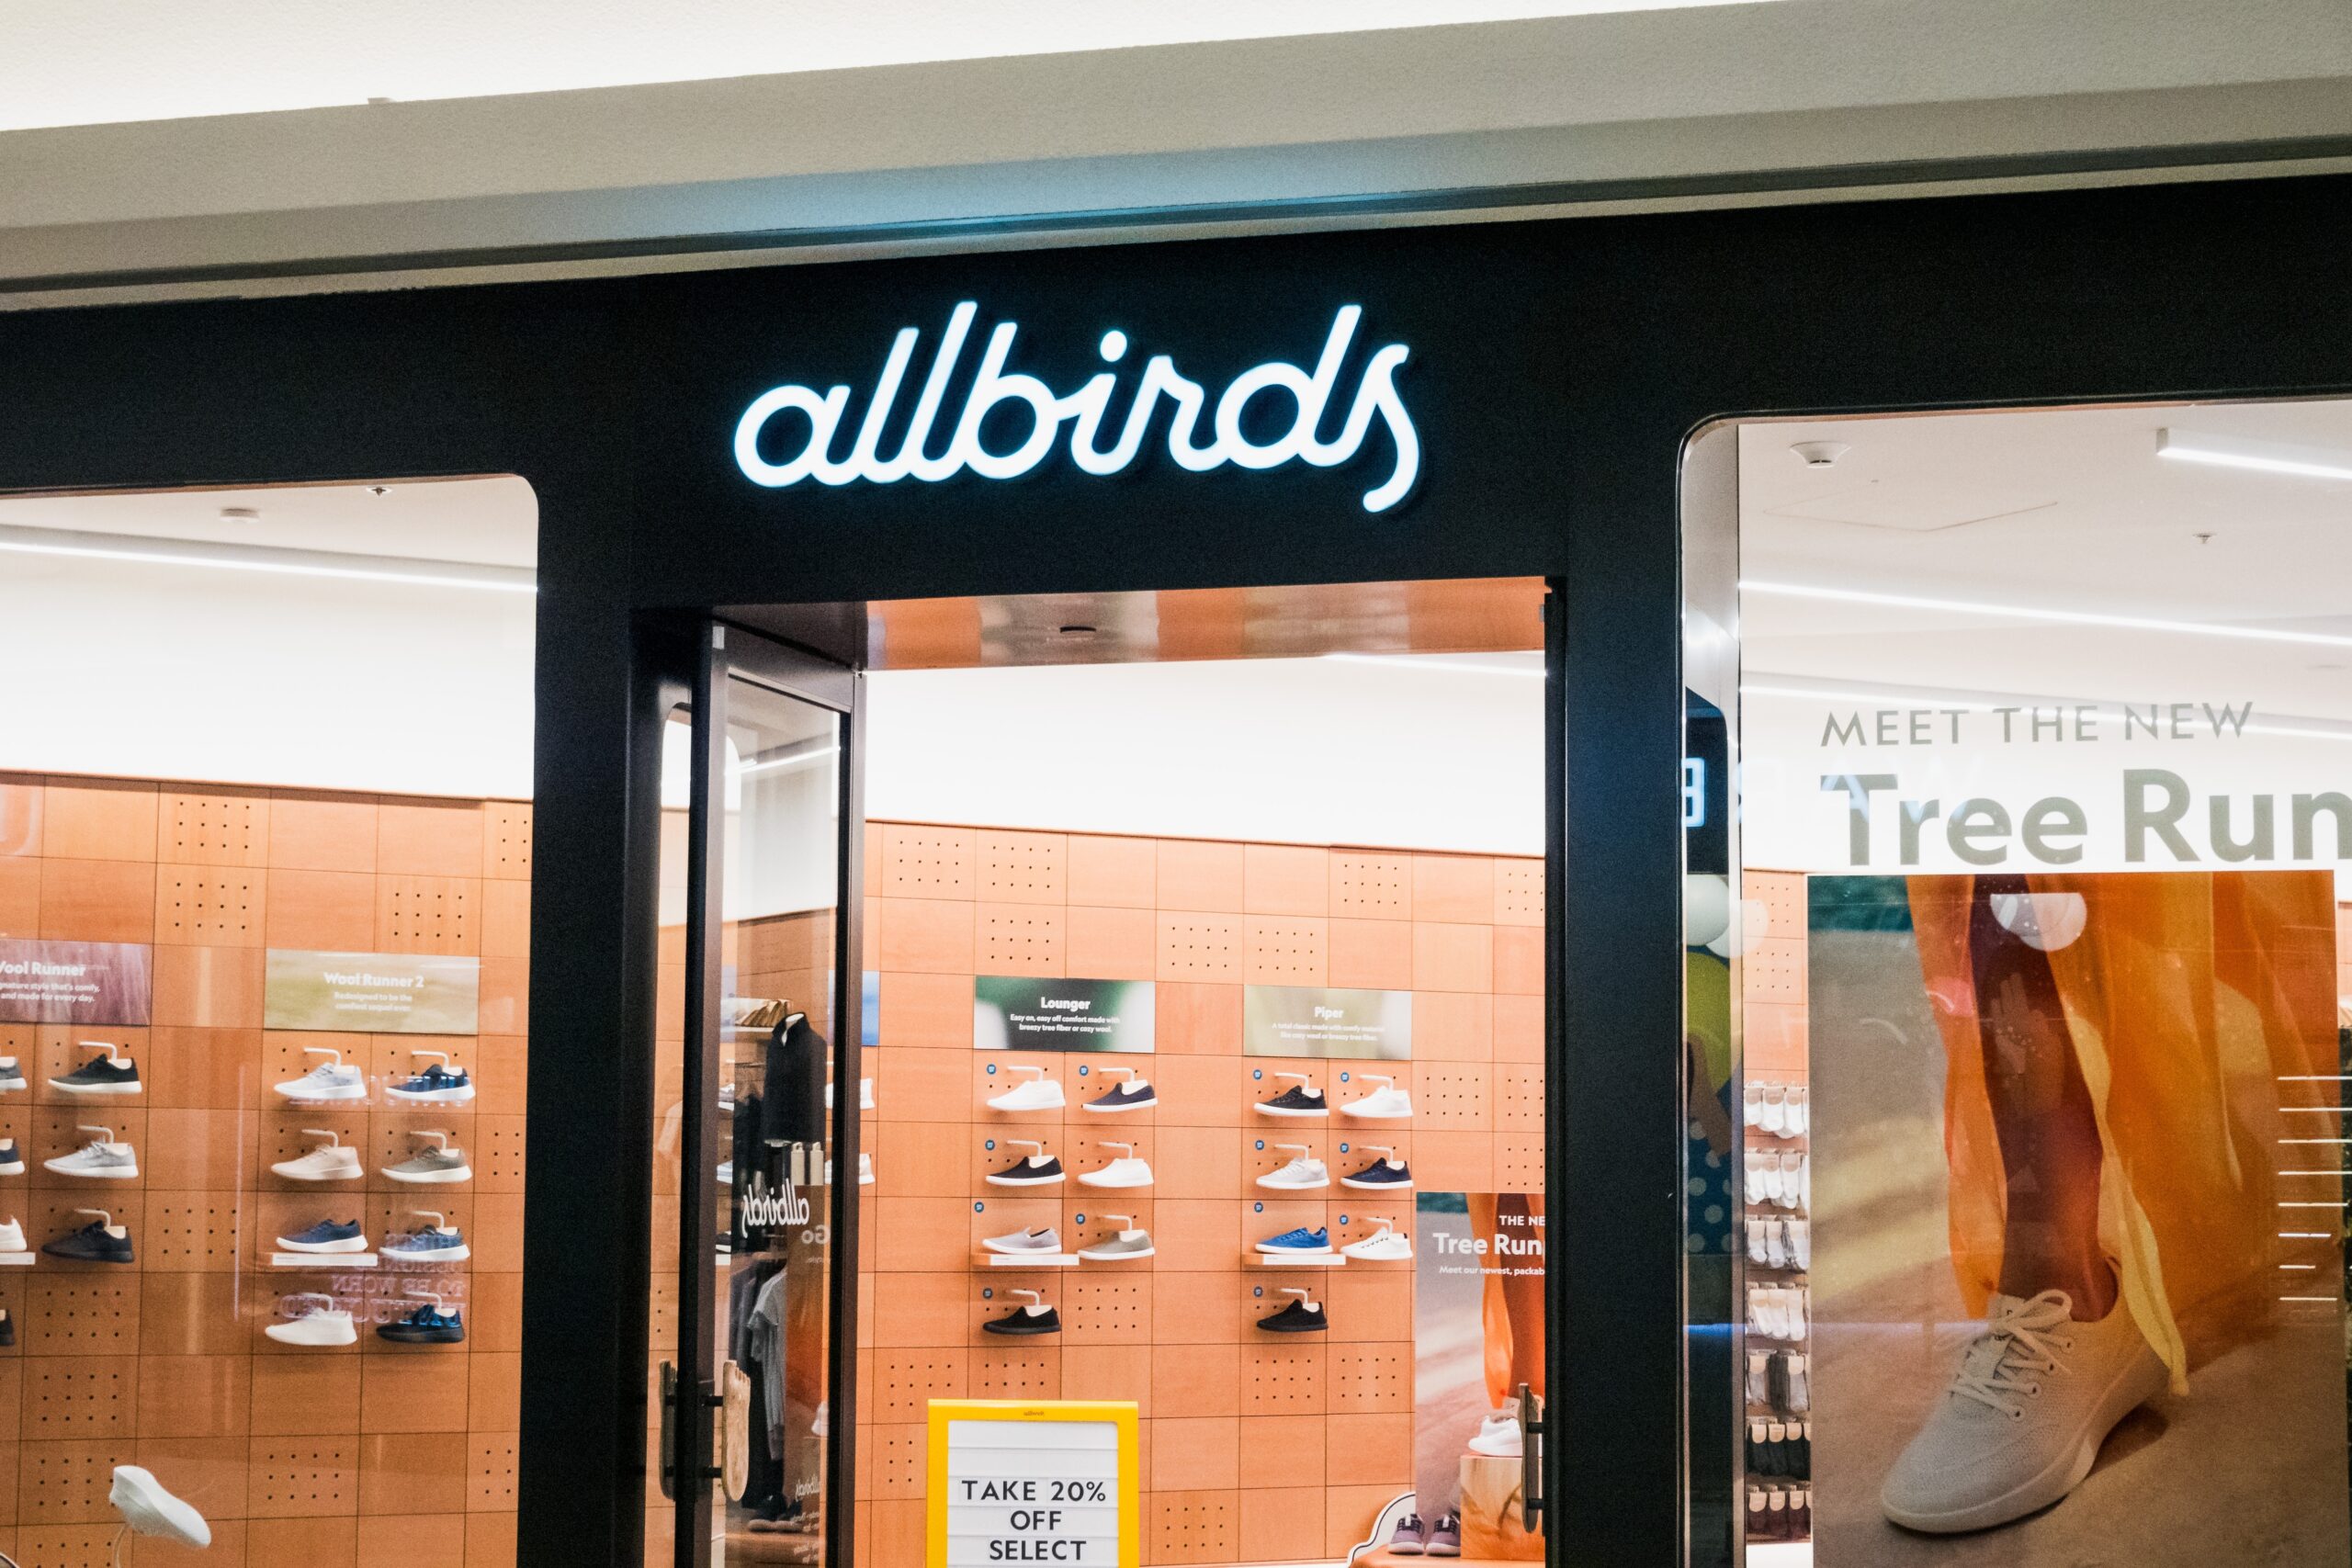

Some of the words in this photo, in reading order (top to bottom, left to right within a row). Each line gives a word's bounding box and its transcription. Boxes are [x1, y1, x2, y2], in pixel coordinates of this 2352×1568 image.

[734, 300, 1419, 513] allbirds
[1820, 709, 1970, 747] MEET
[1993, 705, 2099, 743] THE
[2124, 701, 2254, 741] NEW
[1820, 773, 2088, 867] Tree
[2121, 768, 2352, 863] Run
[31, 962, 86, 976] Runner
[323, 972, 360, 985] Wool
[363, 973, 413, 987] Runner
[415, 975, 424, 987] 2
[1040, 997, 1091, 1012] Lounger
[1011, 1014, 1024, 1022] Easy
[1062, 1015, 1087, 1023] comfort
[1314, 1006, 1344, 1021] Piper
[1019, 1024, 1041, 1032] breezy
[1498, 1214, 1525, 1225] THE
[1528, 1215, 1545, 1225] NE
[1432, 1232, 1488, 1255] Tree
[1494, 1234, 1543, 1256] Run
[1439, 1266, 1463, 1274] Meet
[1480, 1267, 1513, 1276] newest,
[962, 1480, 1036, 1501] TAKE
[1050, 1481, 1106, 1502] 20%
[1010, 1510, 1062, 1530] OFF
[989, 1540, 1087, 1561] SELECT
